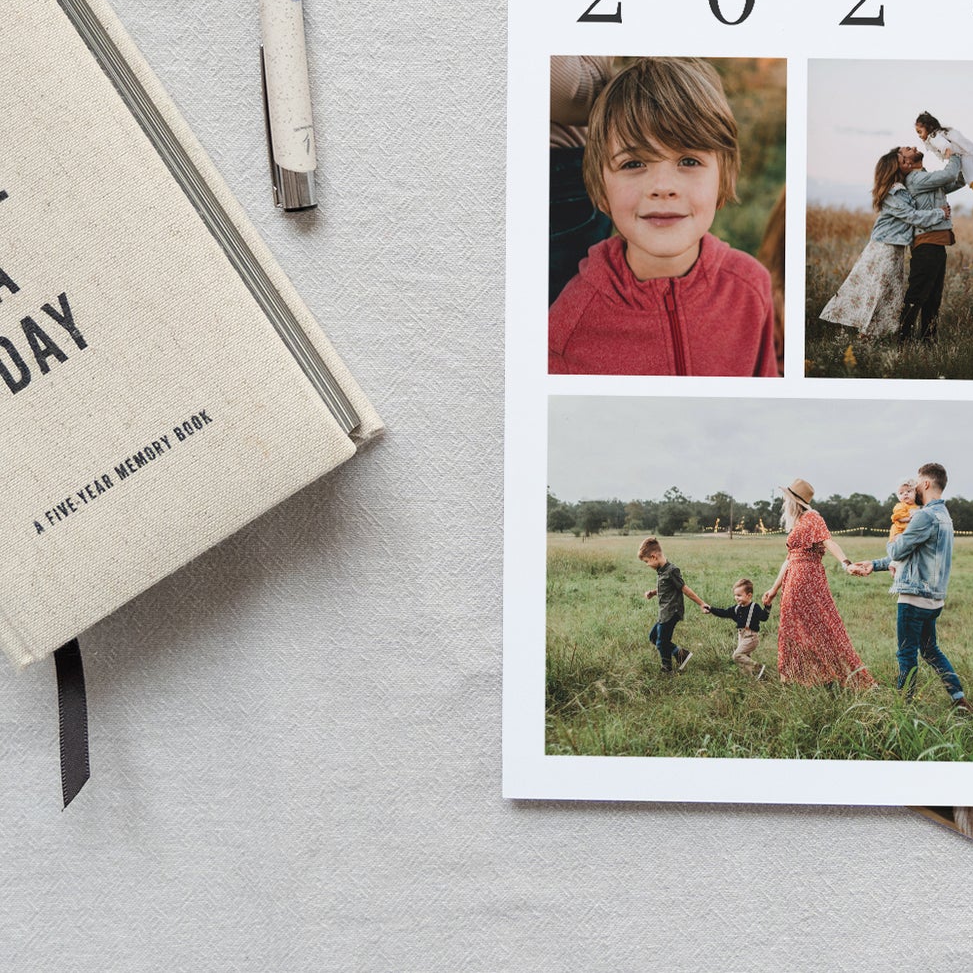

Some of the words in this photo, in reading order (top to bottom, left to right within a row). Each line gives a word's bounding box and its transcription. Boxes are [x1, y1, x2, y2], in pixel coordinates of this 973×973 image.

[0, 291, 88, 395] DAY
[33, 520, 45, 535] A
[45, 474, 114, 526] FIVE-YEAR
[114, 435, 171, 481] MEMORY
[173, 409, 213, 442] BOOK
